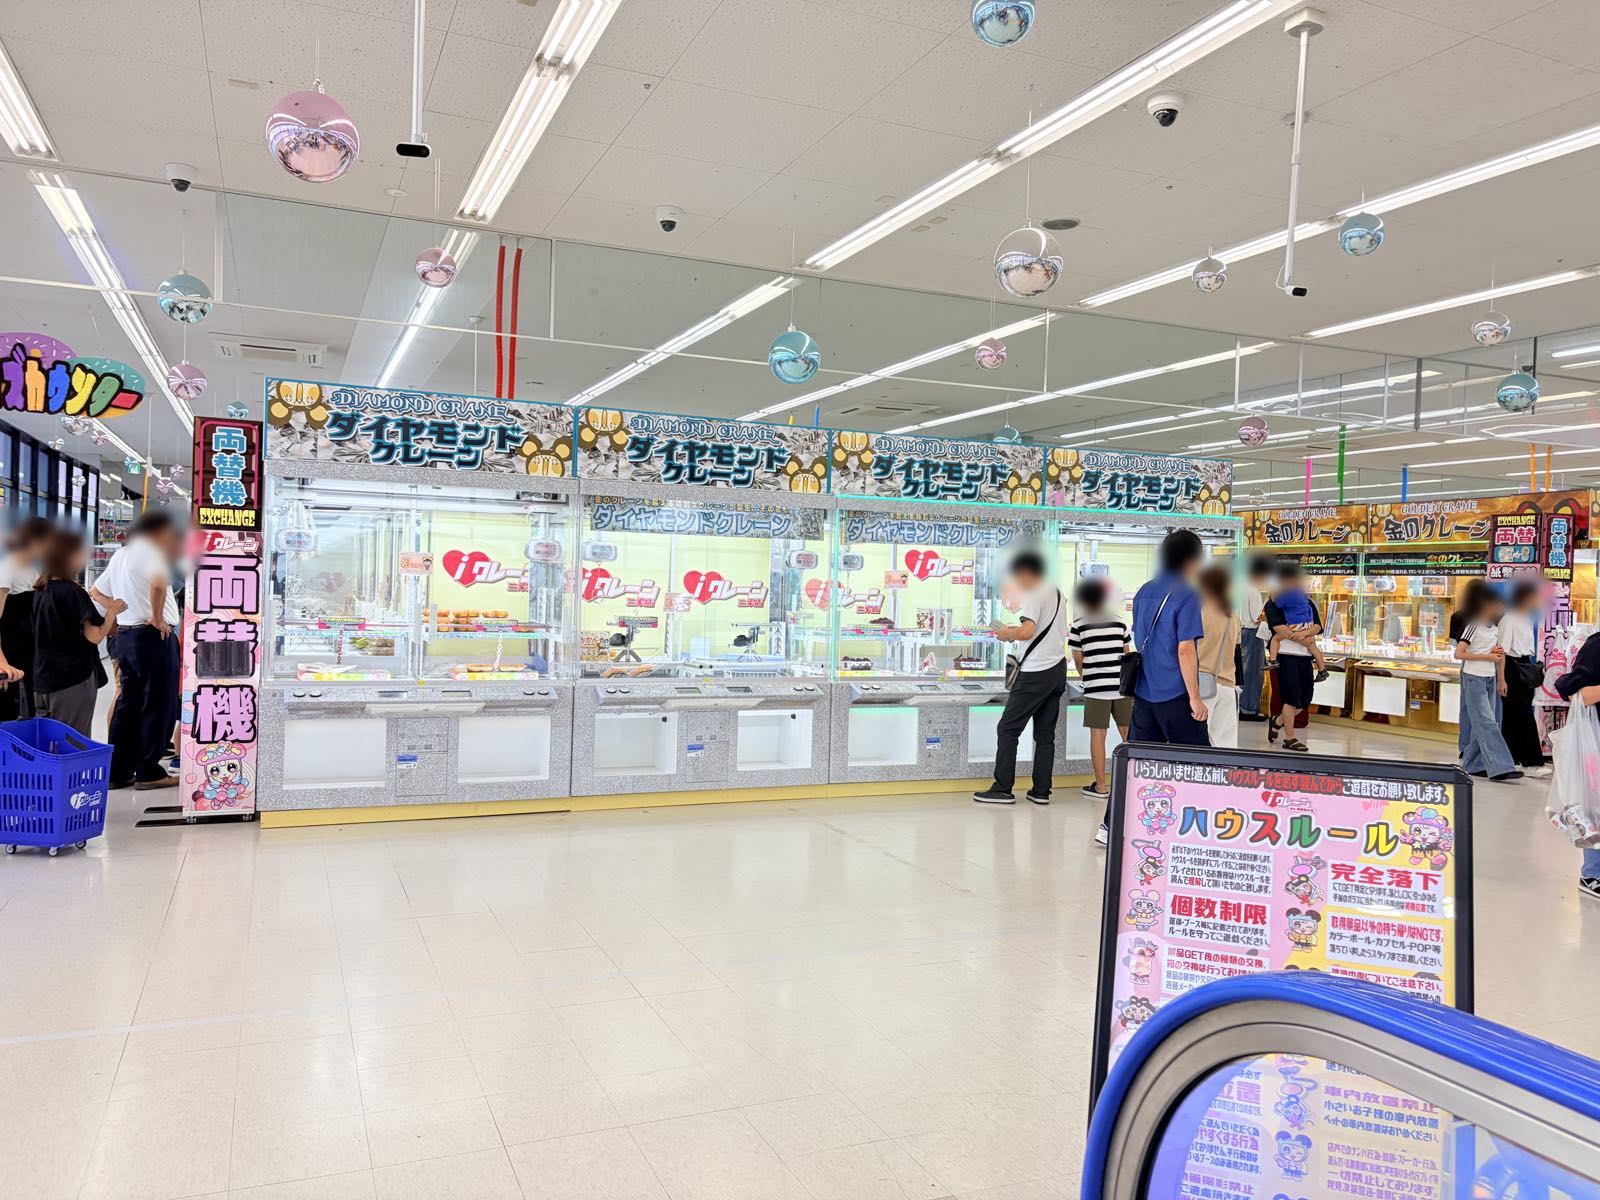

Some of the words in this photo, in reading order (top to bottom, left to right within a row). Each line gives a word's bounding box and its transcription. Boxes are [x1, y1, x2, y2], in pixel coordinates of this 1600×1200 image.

[0, 343, 143, 417] ズカウンター
[331, 388, 433, 414] DIAMOND
[437, 401, 513, 421] CRANE
[326, 410, 526, 453] ダイヤモンド
[631, 415, 715, 438] DIAMOND
[716, 424, 779, 444] CRANE
[370, 443, 483, 469] クレーン
[626, 434, 790, 472] ダイヤモンド
[876, 436, 946, 456] DIAMOND
[947, 444, 1003, 461] CRANE
[210, 426, 247, 506] 両替機
[661, 463, 755, 488] クレーン
[872, 455, 1012, 487] ダイヤモンド
[1085, 452, 1145, 471] DIAMOND
[1146, 458, 1195, 474] CRANE
[901, 480, 981, 501] クレーン
[1080, 469, 1202, 500] ダイヤモンド
[1107, 492, 1176, 513] クレーン
[1401, 501, 1441, 514] GOLDEN
[1442, 500, 1481, 513] CRANE
[199, 508, 256, 527] EXCHANGE
[593, 505, 791, 536] ダイヤモンドクレーン
[1383, 513, 1490, 543] 金のクレーン
[1497, 515, 1536, 526] EXCHANGE
[848, 519, 1014, 546] ダイヤモンドクレーン
[1265, 519, 1348, 545] 金のクレーン
[1495, 526, 1536, 544] 両替
[1549, 518, 1568, 567] 両替機
[1299, 555, 1345, 564] 金のクレーン
[1427, 554, 1484, 562] 金のクレーン
[692, 575, 769, 601] iクレーン
[1178, 805, 1400, 856] ハウスルール
[1330, 863, 1442, 891] 完全落下
[1170, 894, 1267, 926] 個数制限
[1323, 1085, 1440, 1115] 車内放置禁止
[1323, 1100, 1440, 1130] 小さいお子様の車内放置
